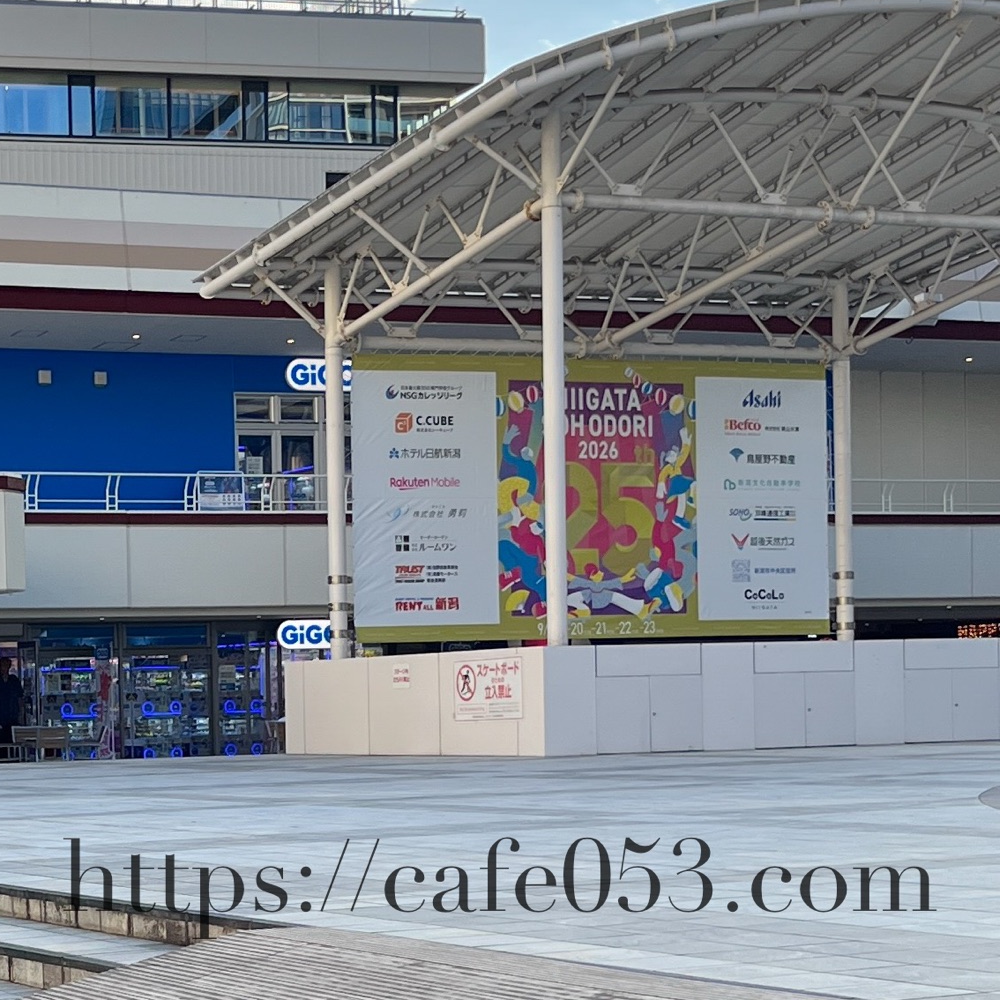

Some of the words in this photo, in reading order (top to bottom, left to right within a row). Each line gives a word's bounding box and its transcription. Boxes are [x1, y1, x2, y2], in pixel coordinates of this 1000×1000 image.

[291, 364, 352, 386] Gi
[742, 389, 782, 409] Asahi
[400, 448, 461, 459] ホテル日航新潟
[578, 441, 619, 460] 2026
[390, 476, 430, 488] Rakuten
[431, 476, 461, 488] Mobile
[419, 543, 457, 552] ルームワン
[395, 565, 425, 574] TRUST
[476, 661, 520, 677] スケートボード
[484, 684, 512, 699] 立入禁止
